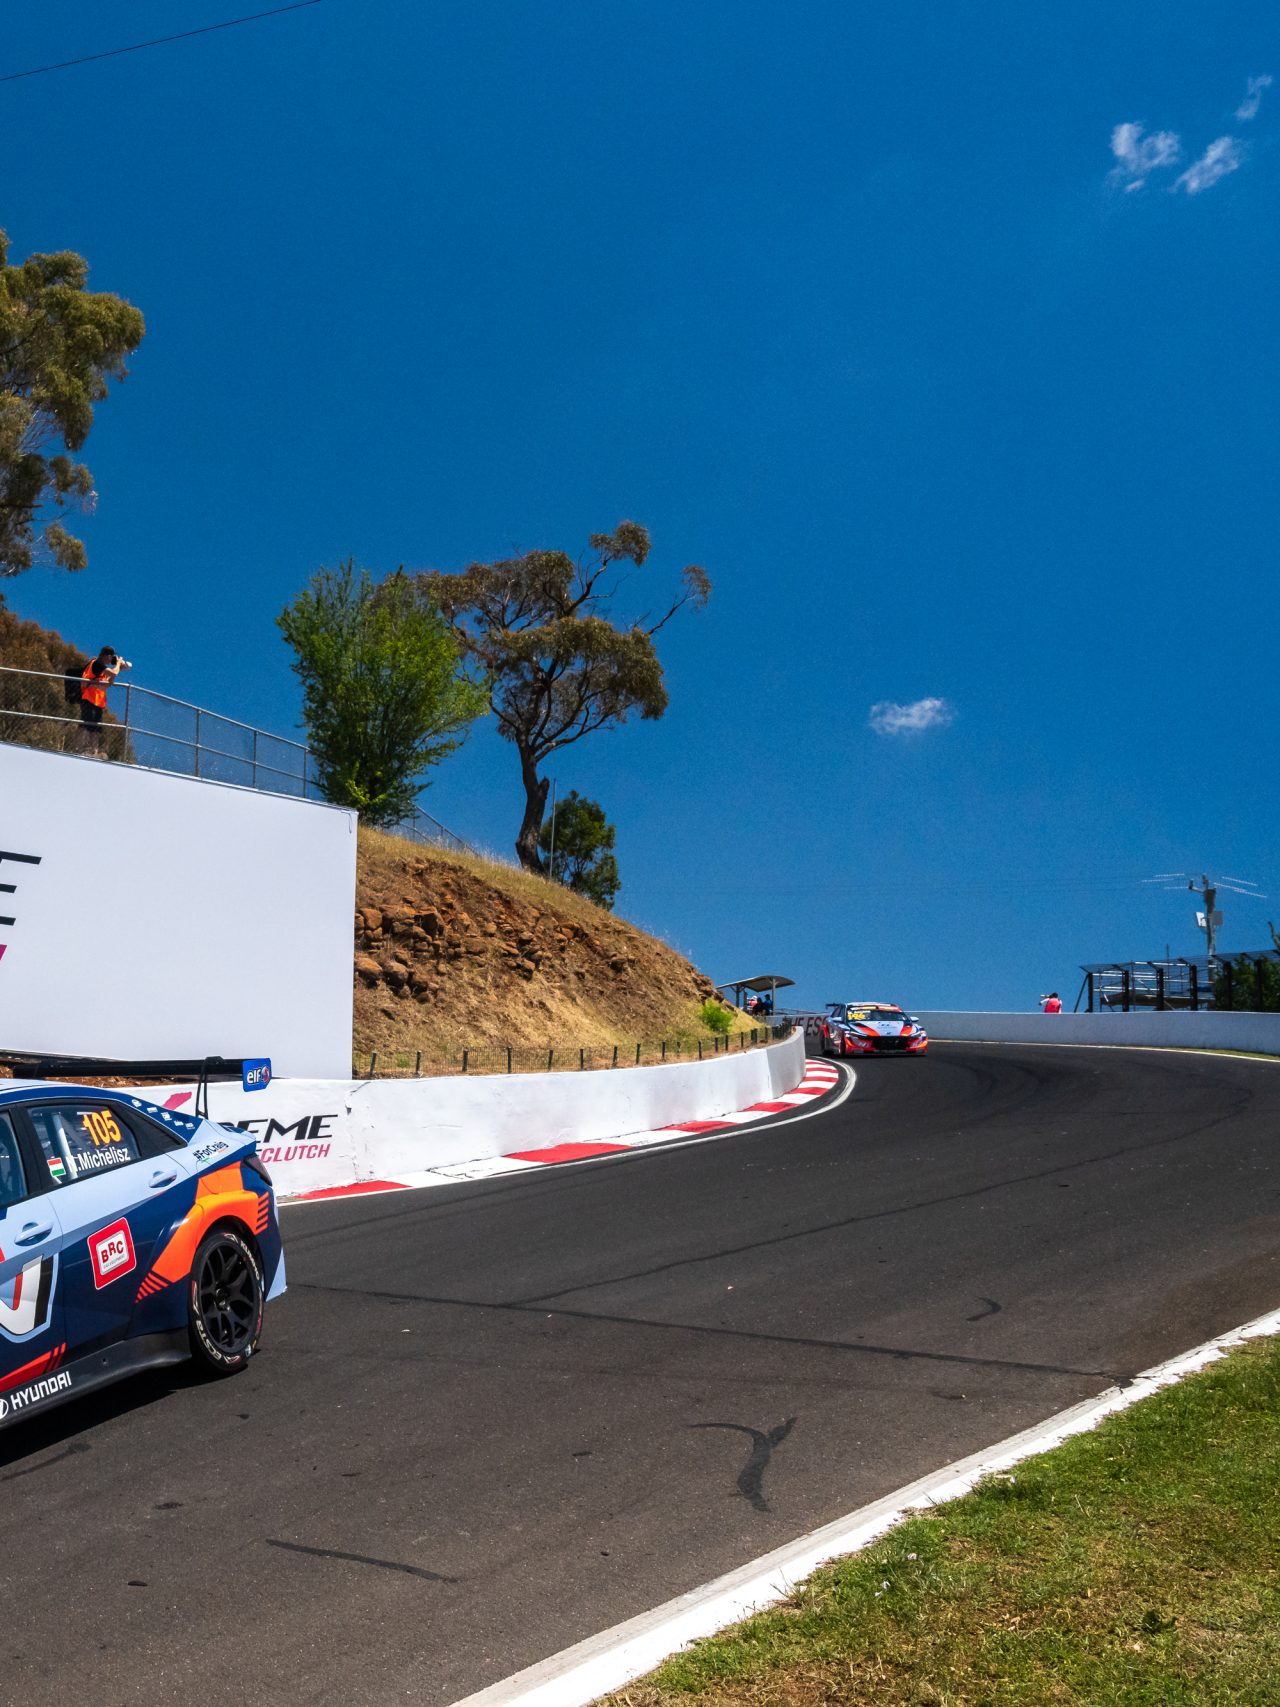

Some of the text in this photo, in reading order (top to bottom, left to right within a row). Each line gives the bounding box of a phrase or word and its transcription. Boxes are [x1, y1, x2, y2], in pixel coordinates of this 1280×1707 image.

[247, 1069, 261, 1084] elf
[83, 1110, 121, 1146] 105
[101, 1240, 124, 1263] BRC
[11, 1371, 72, 1410] HYUNDAI
